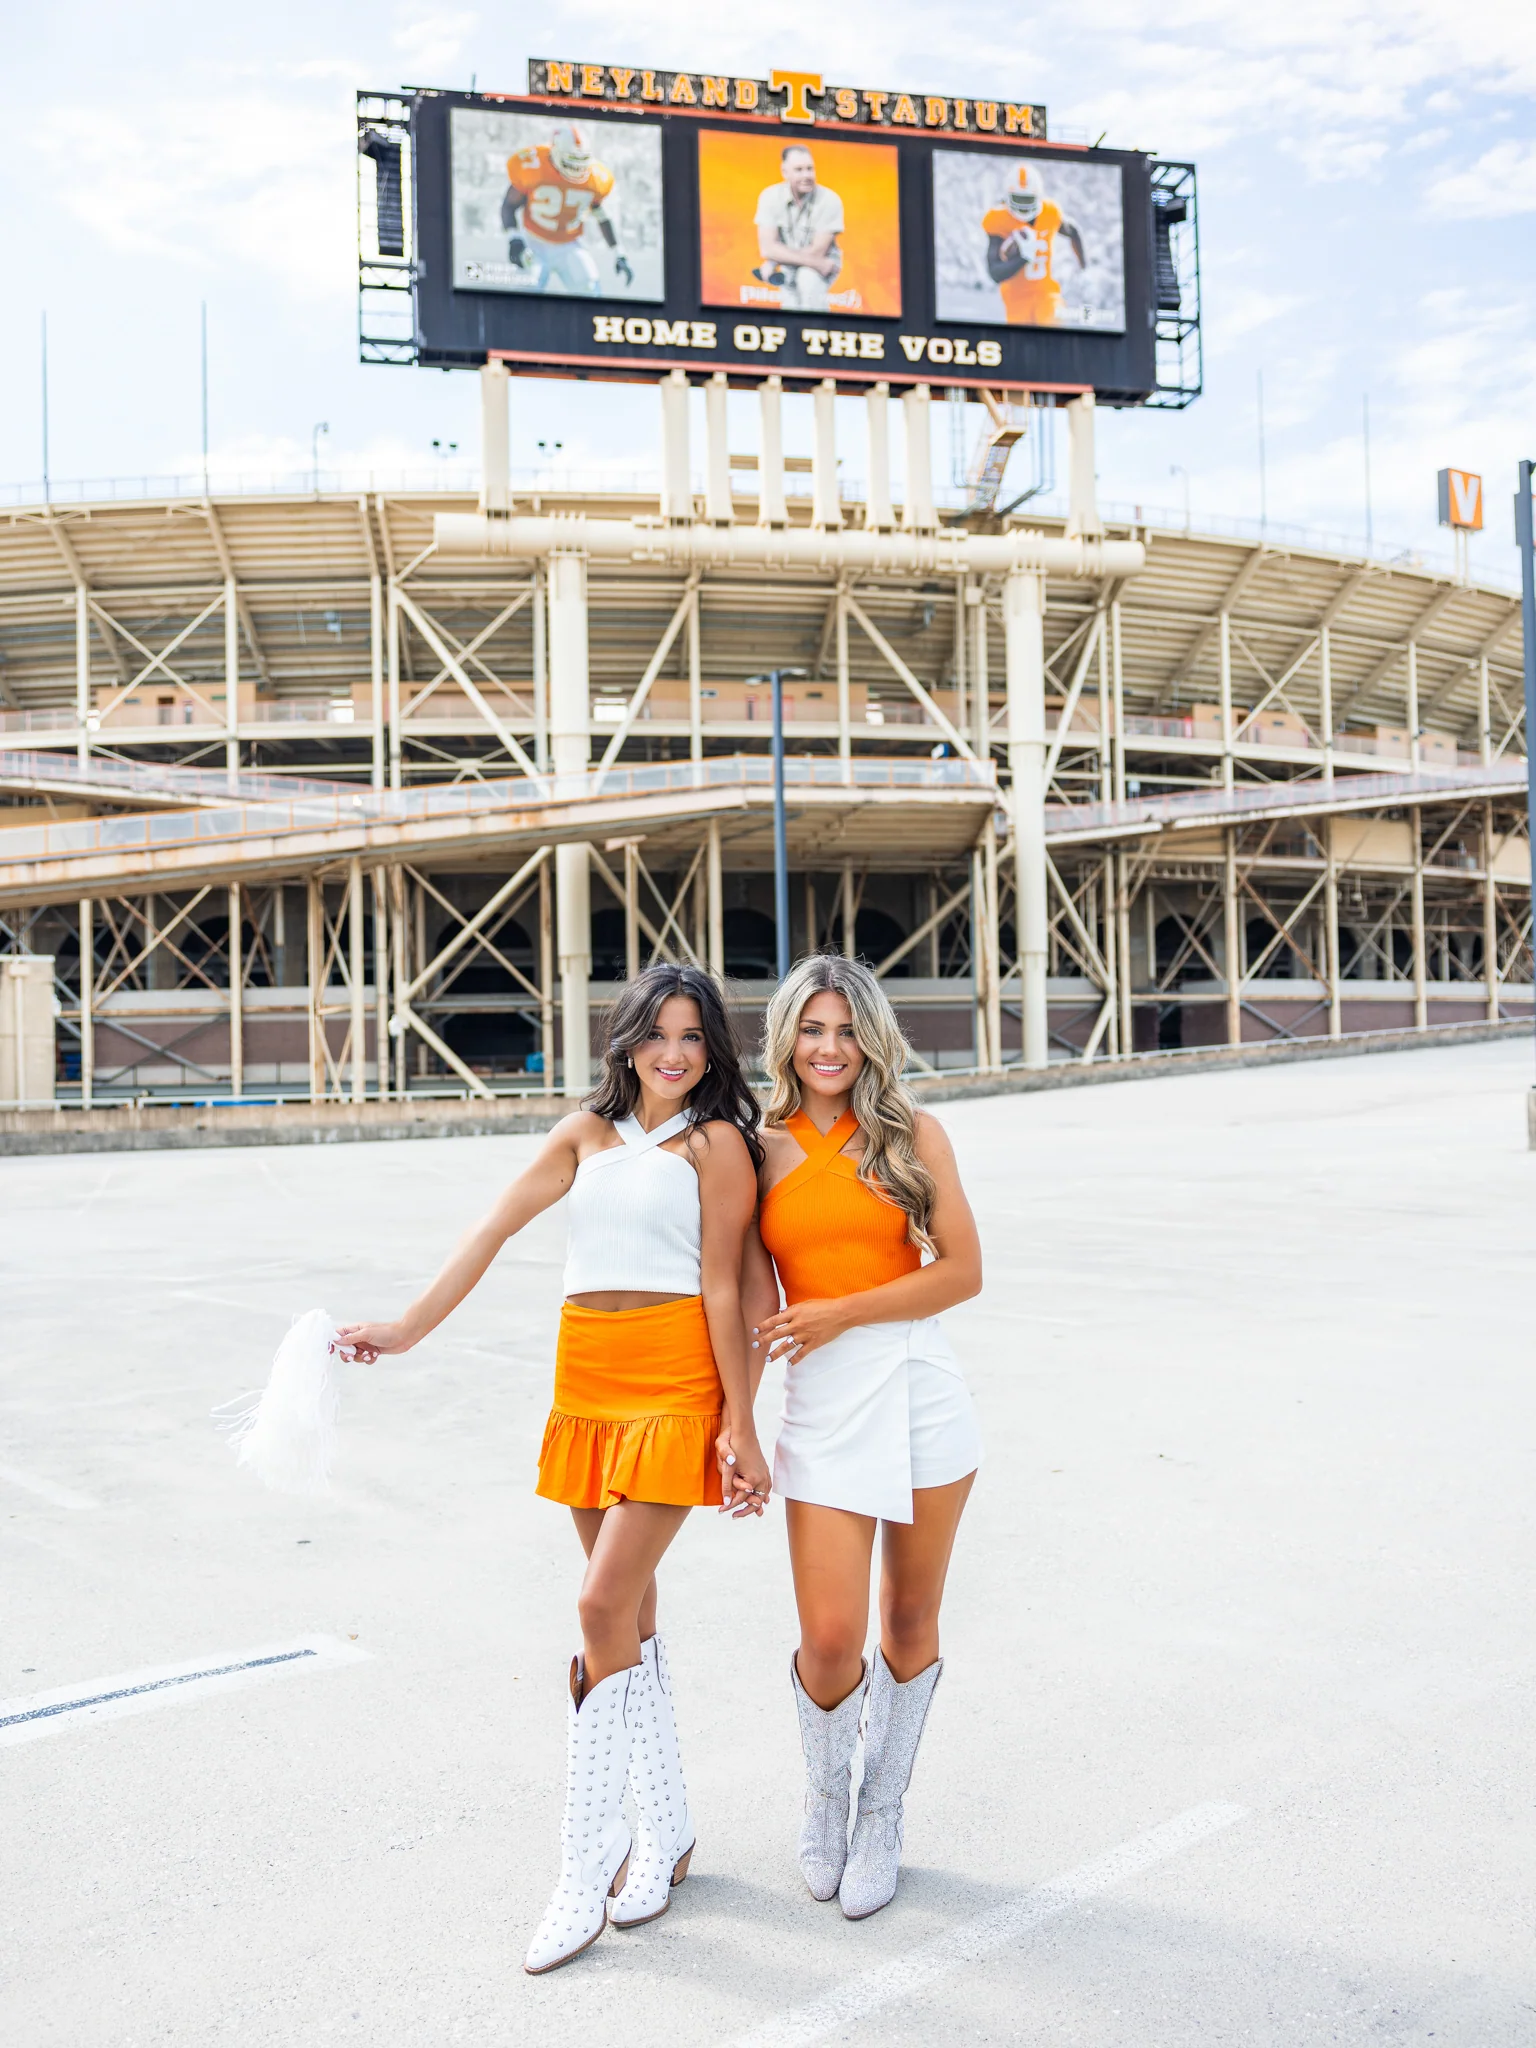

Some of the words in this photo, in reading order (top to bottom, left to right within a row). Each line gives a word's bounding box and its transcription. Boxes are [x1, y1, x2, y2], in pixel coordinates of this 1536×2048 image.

[546, 61, 758, 109] NEYLAND
[768, 69, 825, 124] T
[835, 88, 1033, 133] STADIUM
[530, 185, 594, 231] 27
[593, 316, 717, 348] HOME
[733, 325, 786, 352] OF
[802, 328, 884, 359] THE
[899, 335, 1002, 366] VOLS
[1451, 471, 1480, 523] V
